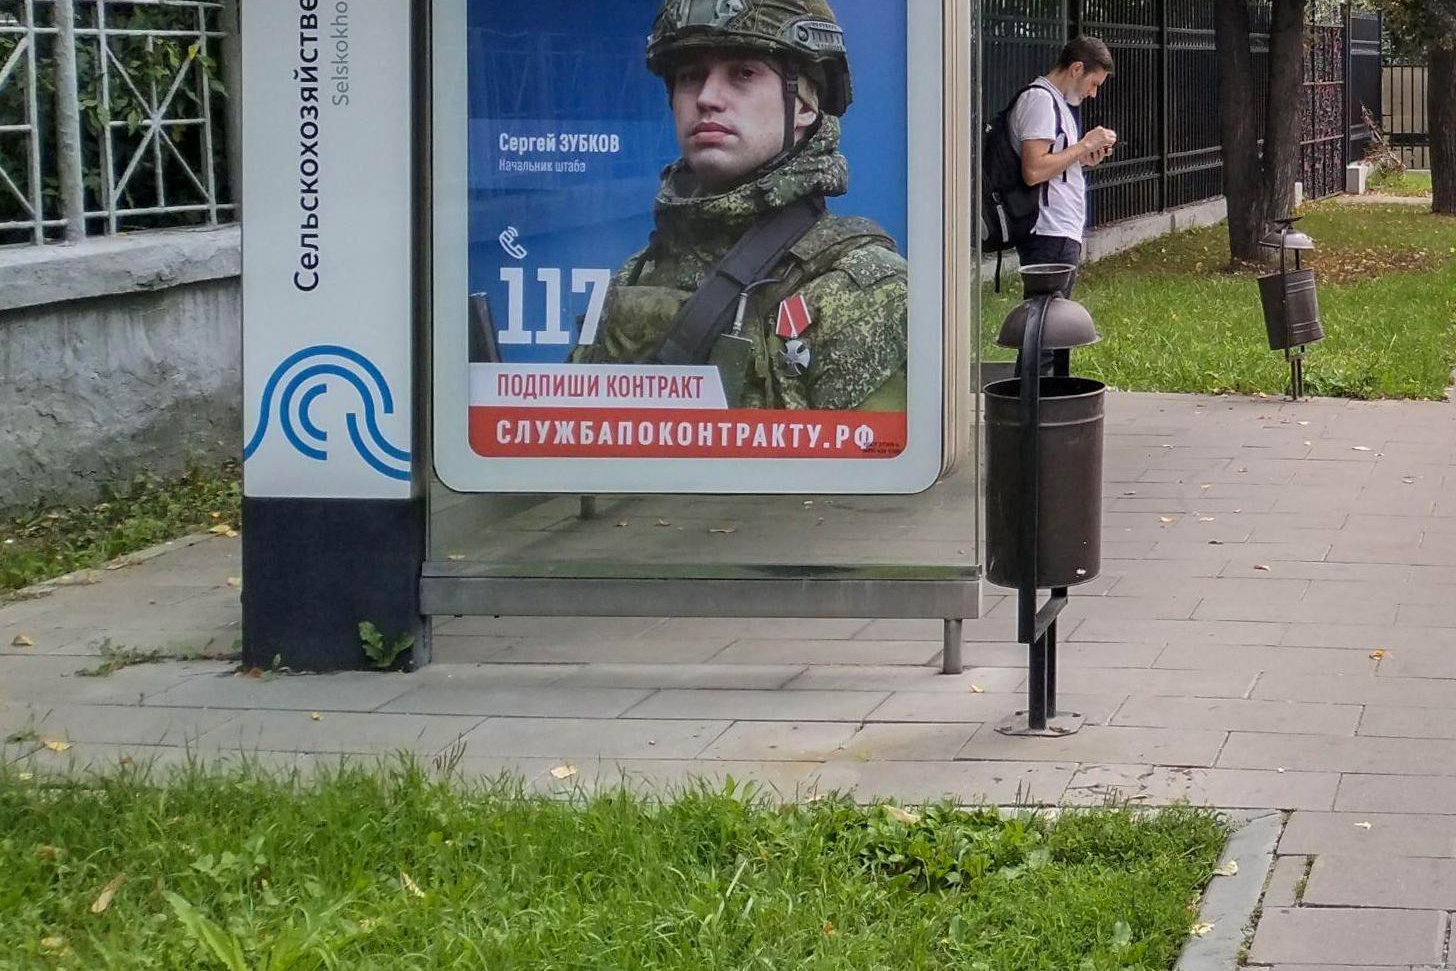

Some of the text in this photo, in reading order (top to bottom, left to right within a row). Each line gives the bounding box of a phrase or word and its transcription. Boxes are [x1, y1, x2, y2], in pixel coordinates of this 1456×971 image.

[499, 132, 620, 155] Сергей ЗУБКОВ
[499, 158, 586, 172] Начальник штаба
[498, 267, 611, 345] 117
[497, 372, 704, 400] ПОДПИШИ КОНТРАКТ
[496, 420, 874, 450] СЛУЖБАПОКОНТРАКТУ.РФ
